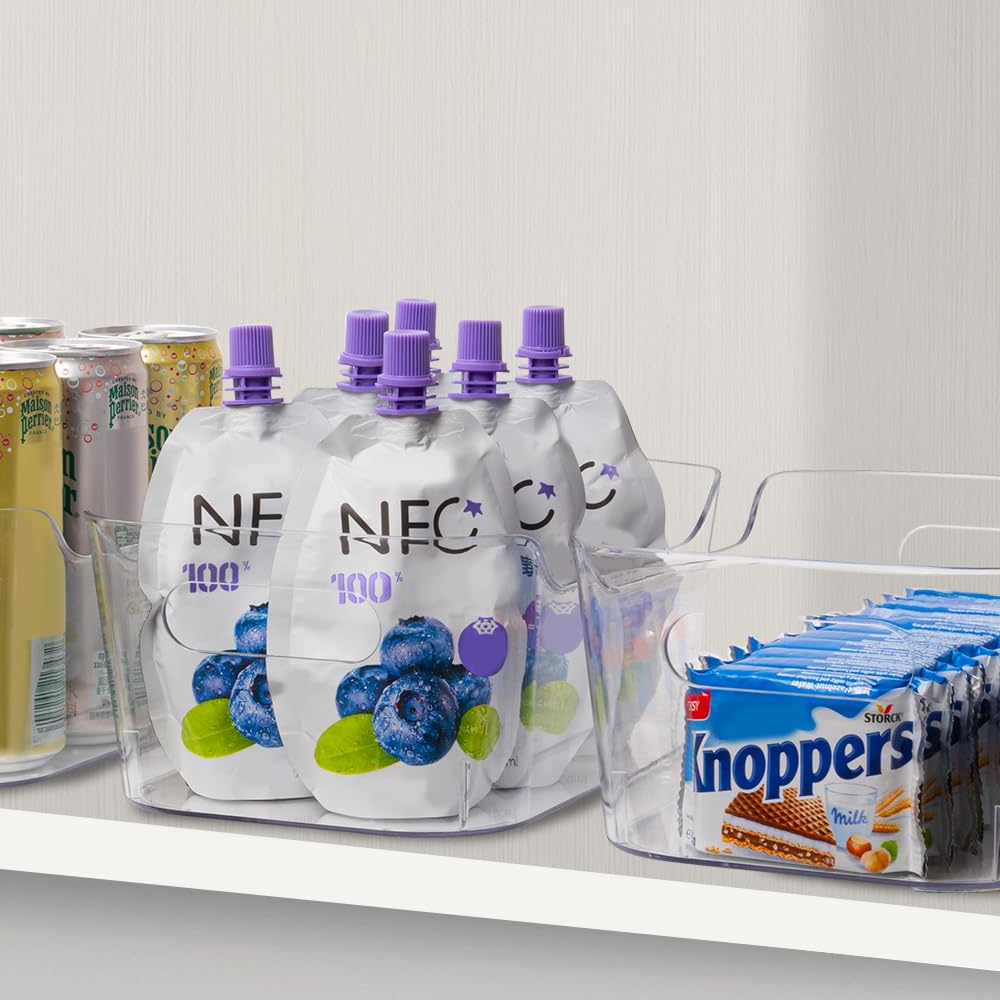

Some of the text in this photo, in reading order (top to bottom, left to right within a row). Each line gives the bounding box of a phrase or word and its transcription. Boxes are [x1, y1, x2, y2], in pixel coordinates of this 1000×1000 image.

[109, 382, 139, 402] Maison
[21, 395, 52, 414] Maison
[339, 496, 479, 555] NFC
[863, 712, 902, 723] STORCK
[693, 720, 914, 801] Knoppers
[831, 807, 869, 827] Milk
